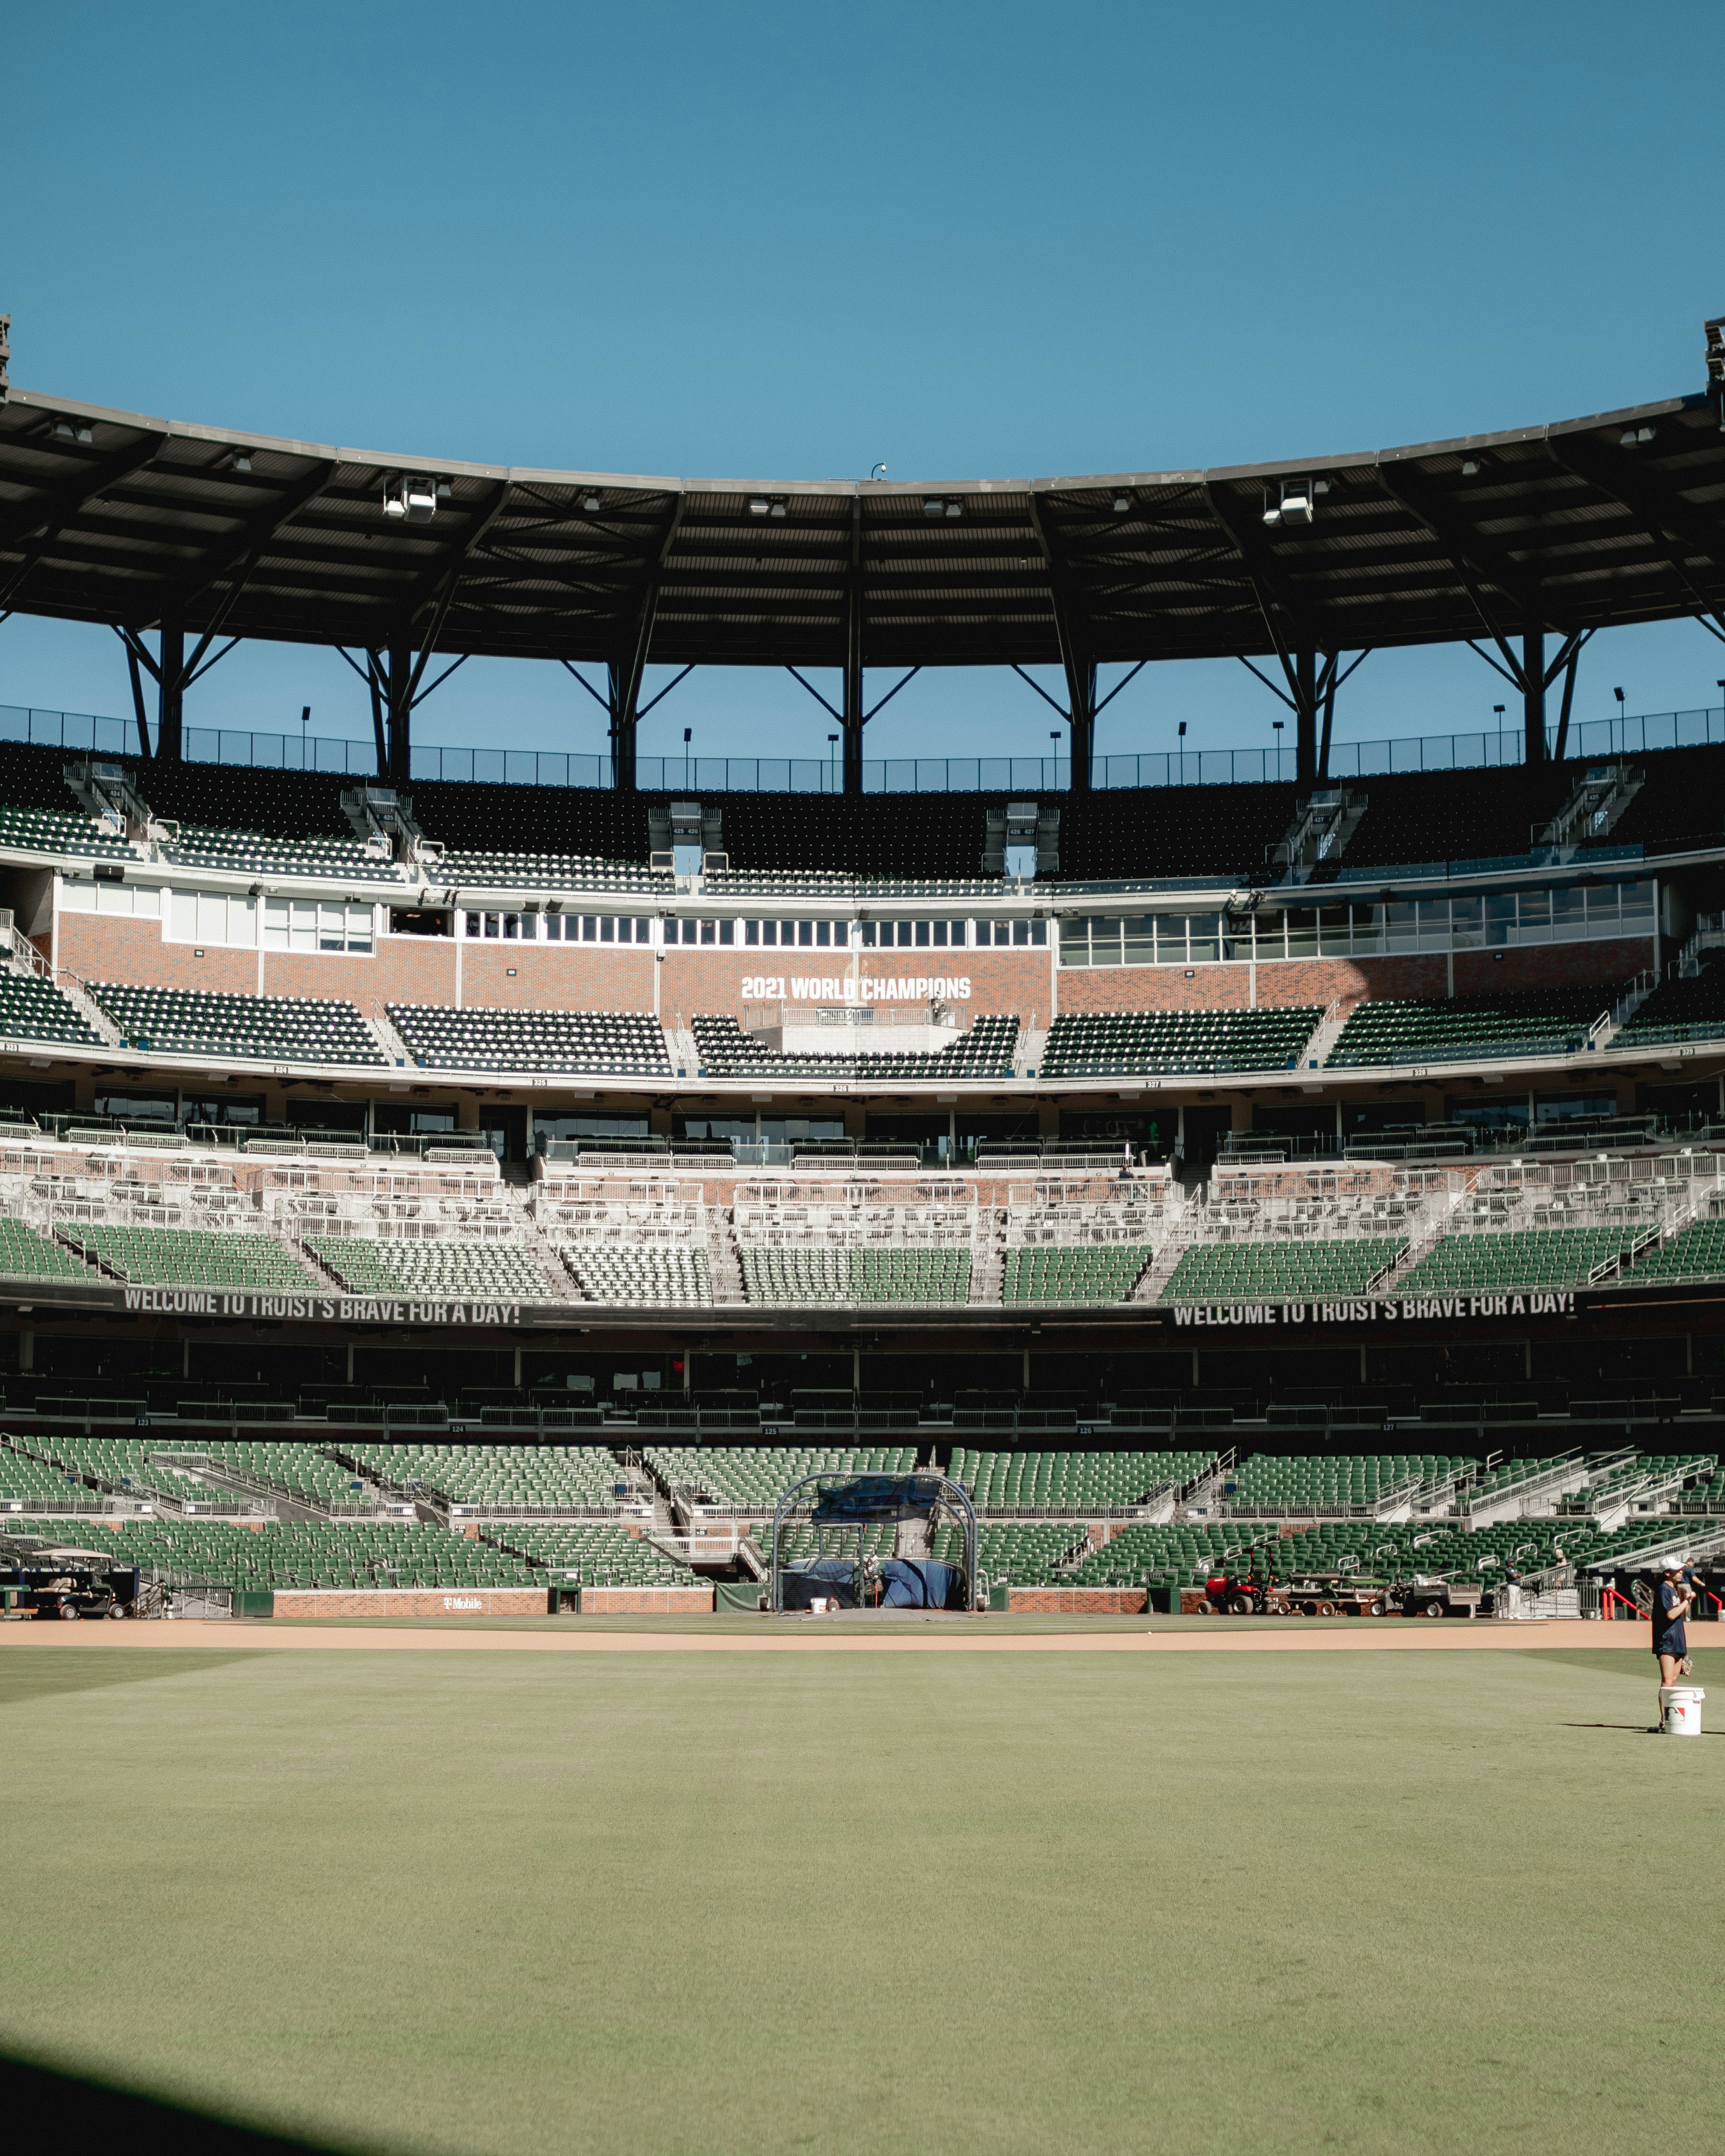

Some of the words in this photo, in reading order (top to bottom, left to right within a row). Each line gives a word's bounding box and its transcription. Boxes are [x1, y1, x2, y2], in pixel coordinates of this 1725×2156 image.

[742, 977, 787, 999] 2021
[791, 977, 856, 999] WORLD
[861, 977, 971, 999] CHAMPIONS
[6, 1044, 17, 1052] 323
[1682, 1048, 1693, 1056] 329
[125, 1289, 217, 1313] WELCOME
[223, 1294, 245, 1314] TO
[340, 1300, 404, 1321] BRAVE
[409, 1302, 447, 1322] FOR
[452, 1303, 466, 1323] A
[472, 1305, 520, 1324] DAY!
[1174, 1304, 1276, 1325] WELCOME
[1283, 1303, 1305, 1322] TO
[1403, 1298, 1465, 1319] BRAVE
[1471, 1296, 1508, 1316] FOR
[1511, 1294, 1526, 1315] A
[1530, 1293, 1575, 1314] DAY!
